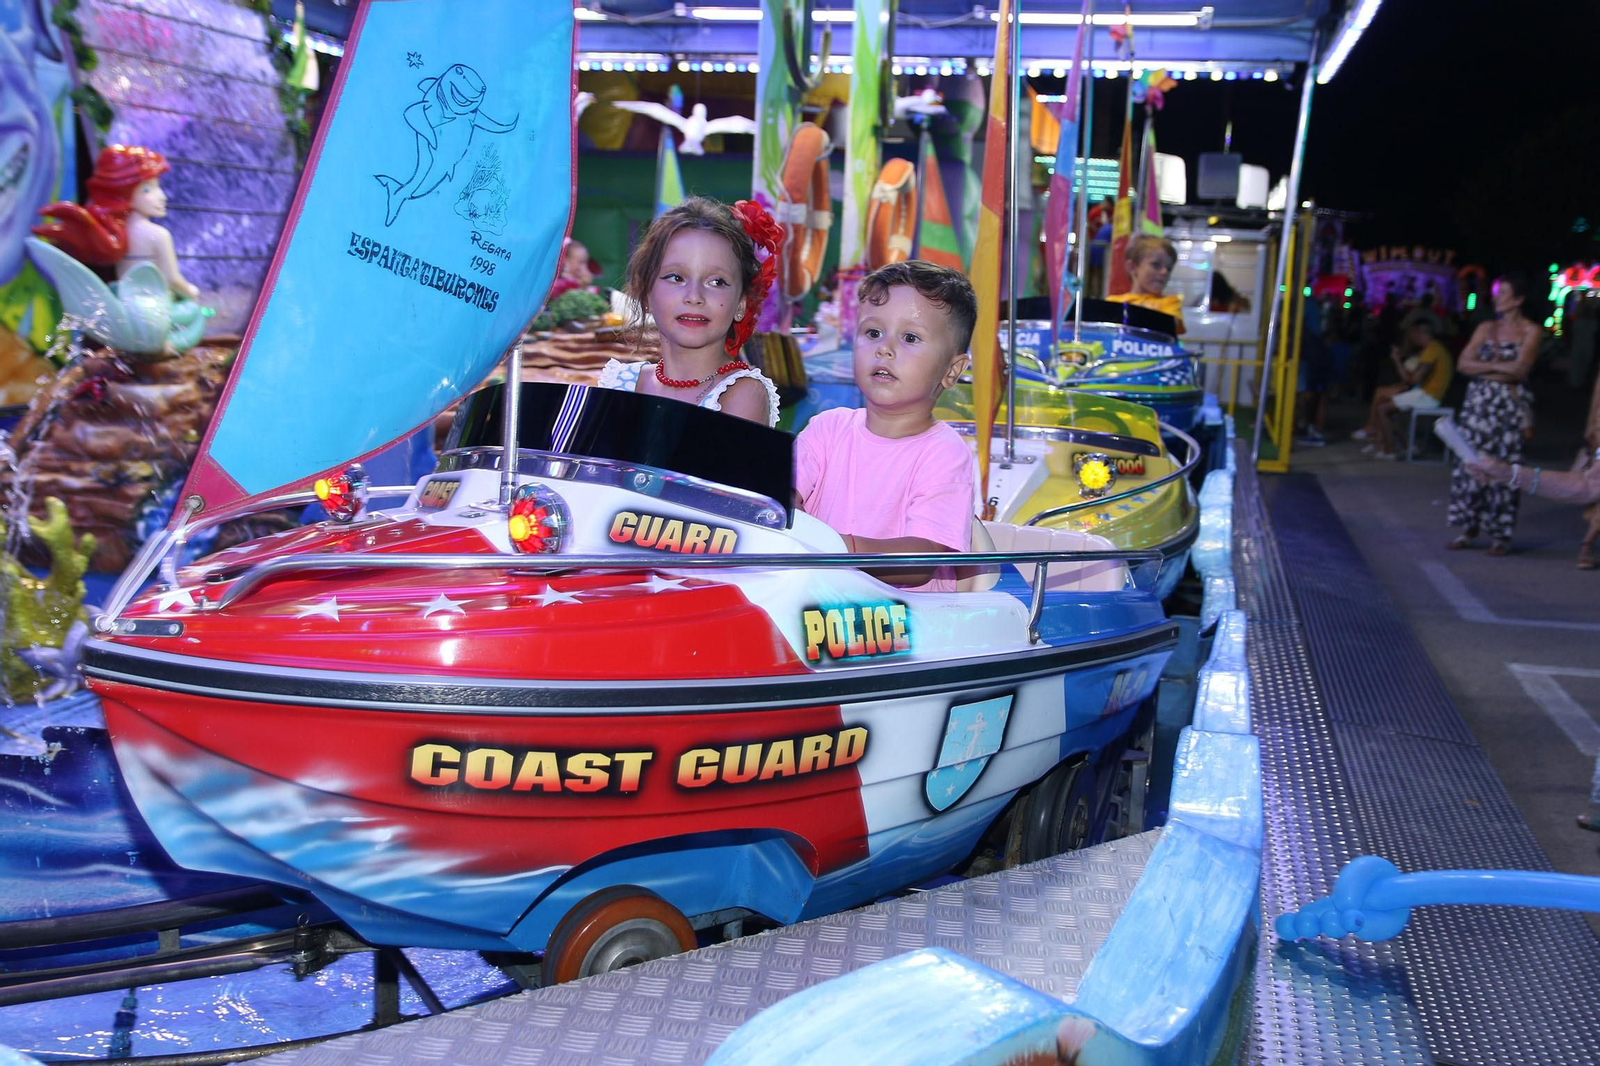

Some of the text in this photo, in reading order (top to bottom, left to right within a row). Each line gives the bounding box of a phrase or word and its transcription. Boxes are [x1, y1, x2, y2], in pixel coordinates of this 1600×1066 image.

[470, 255, 497, 276] 1998
[1112, 339, 1174, 357] POLICIA
[609, 511, 738, 554] GUARD
[804, 604, 911, 660] POLICE
[410, 726, 869, 793] COAST GUARD
